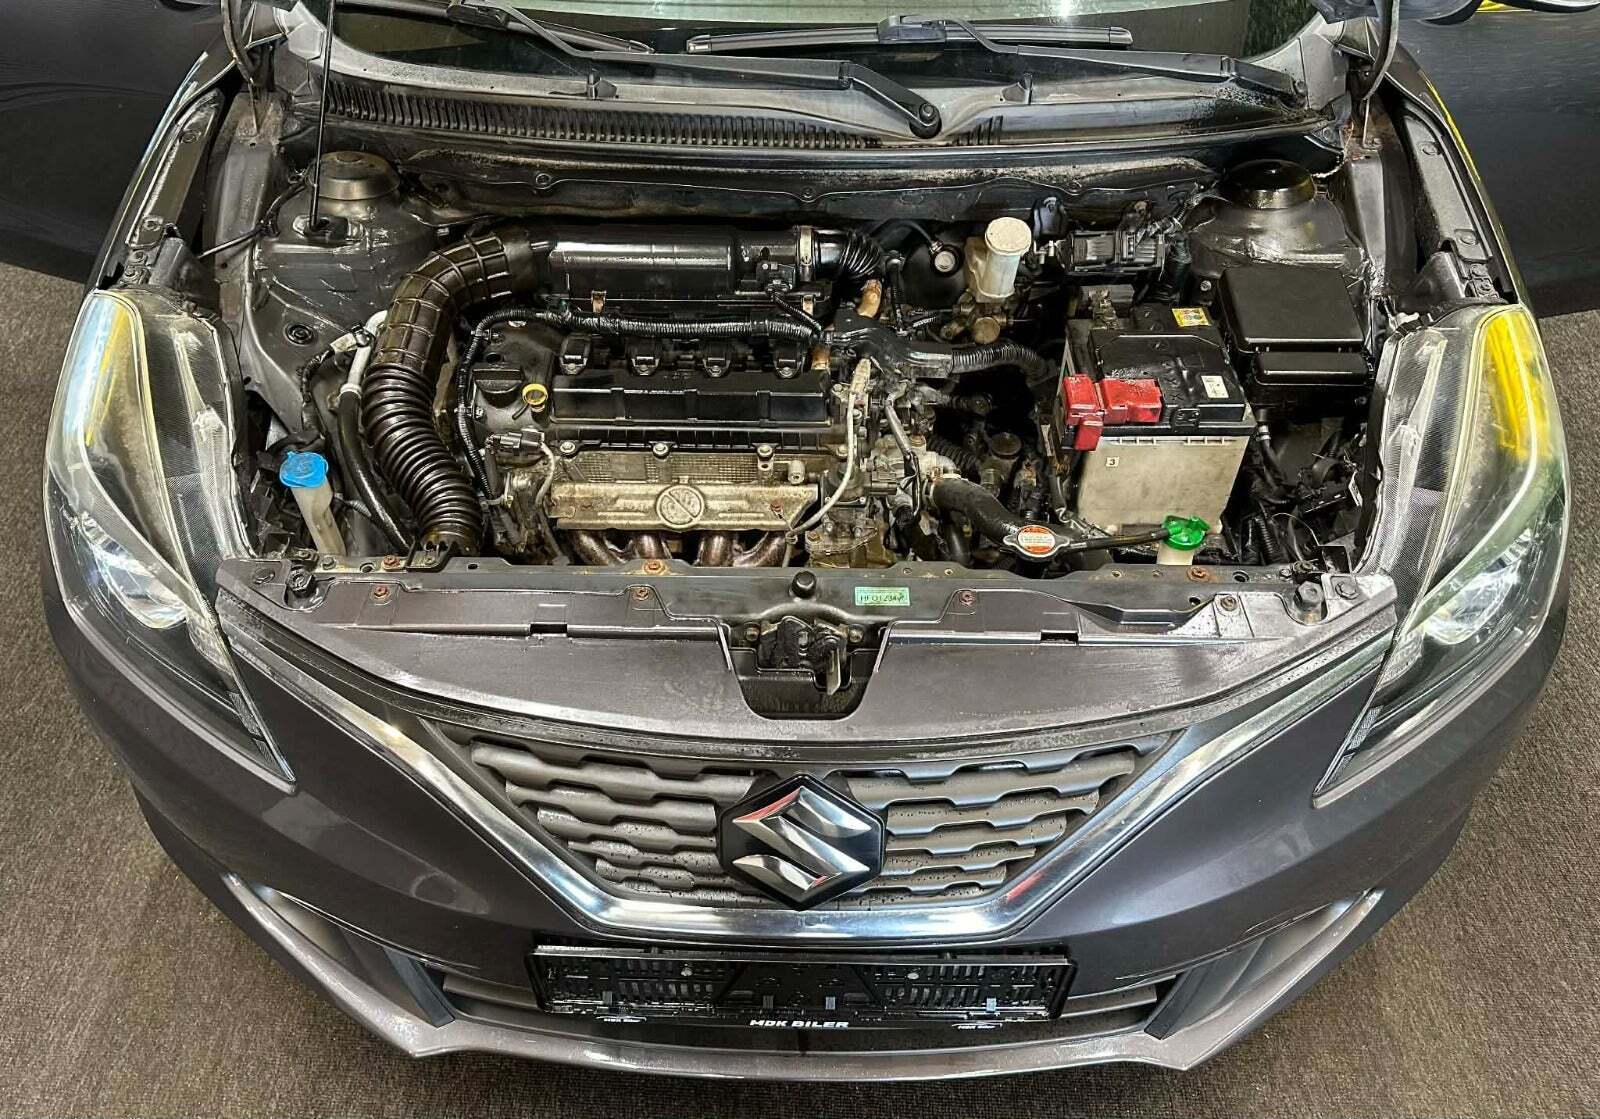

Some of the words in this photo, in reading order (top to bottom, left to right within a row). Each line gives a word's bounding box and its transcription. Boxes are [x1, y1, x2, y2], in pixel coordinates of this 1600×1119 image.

[1109, 458, 1116, 466] 3
[749, 1019, 788, 1027] MDK
[791, 1020, 849, 1028] BILER
